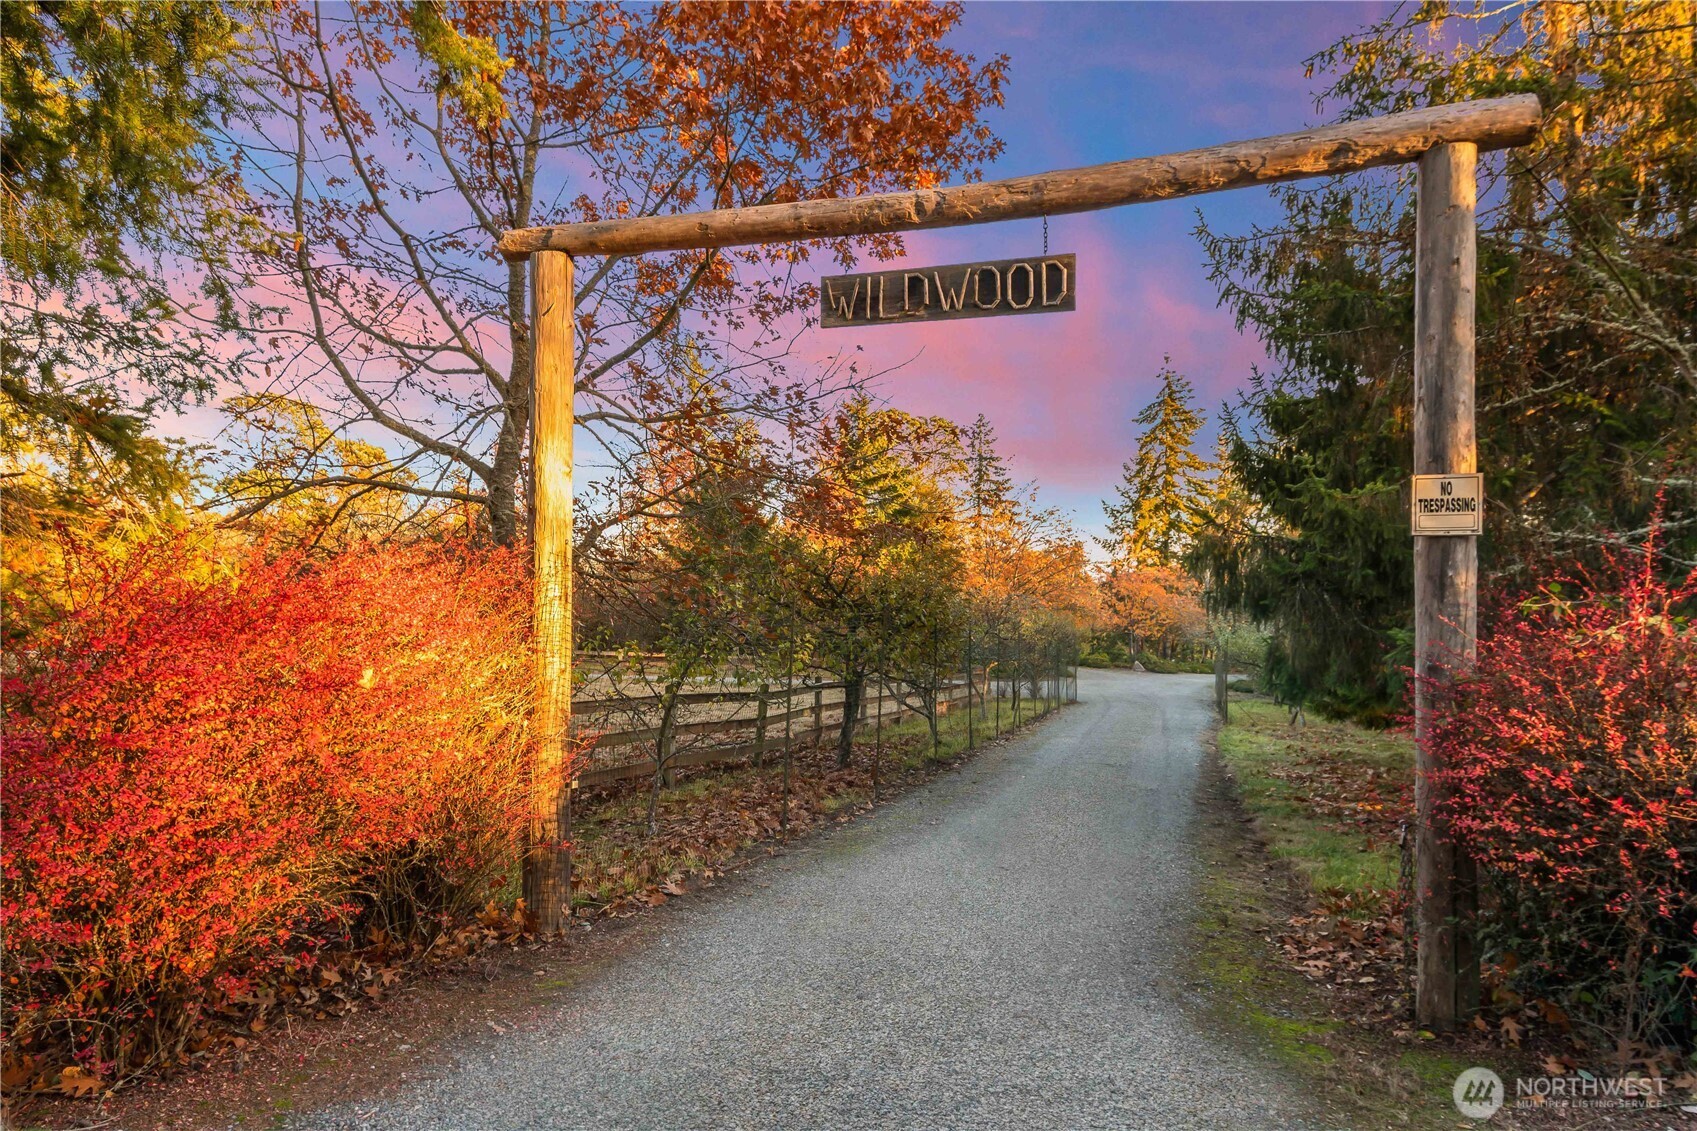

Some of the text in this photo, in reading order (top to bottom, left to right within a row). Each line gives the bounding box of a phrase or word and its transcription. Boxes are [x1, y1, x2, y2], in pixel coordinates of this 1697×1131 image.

[825, 259, 1068, 320] WILDWOOD
[1440, 481, 1453, 496] NO
[1418, 497, 1476, 513] TRESPASSING
